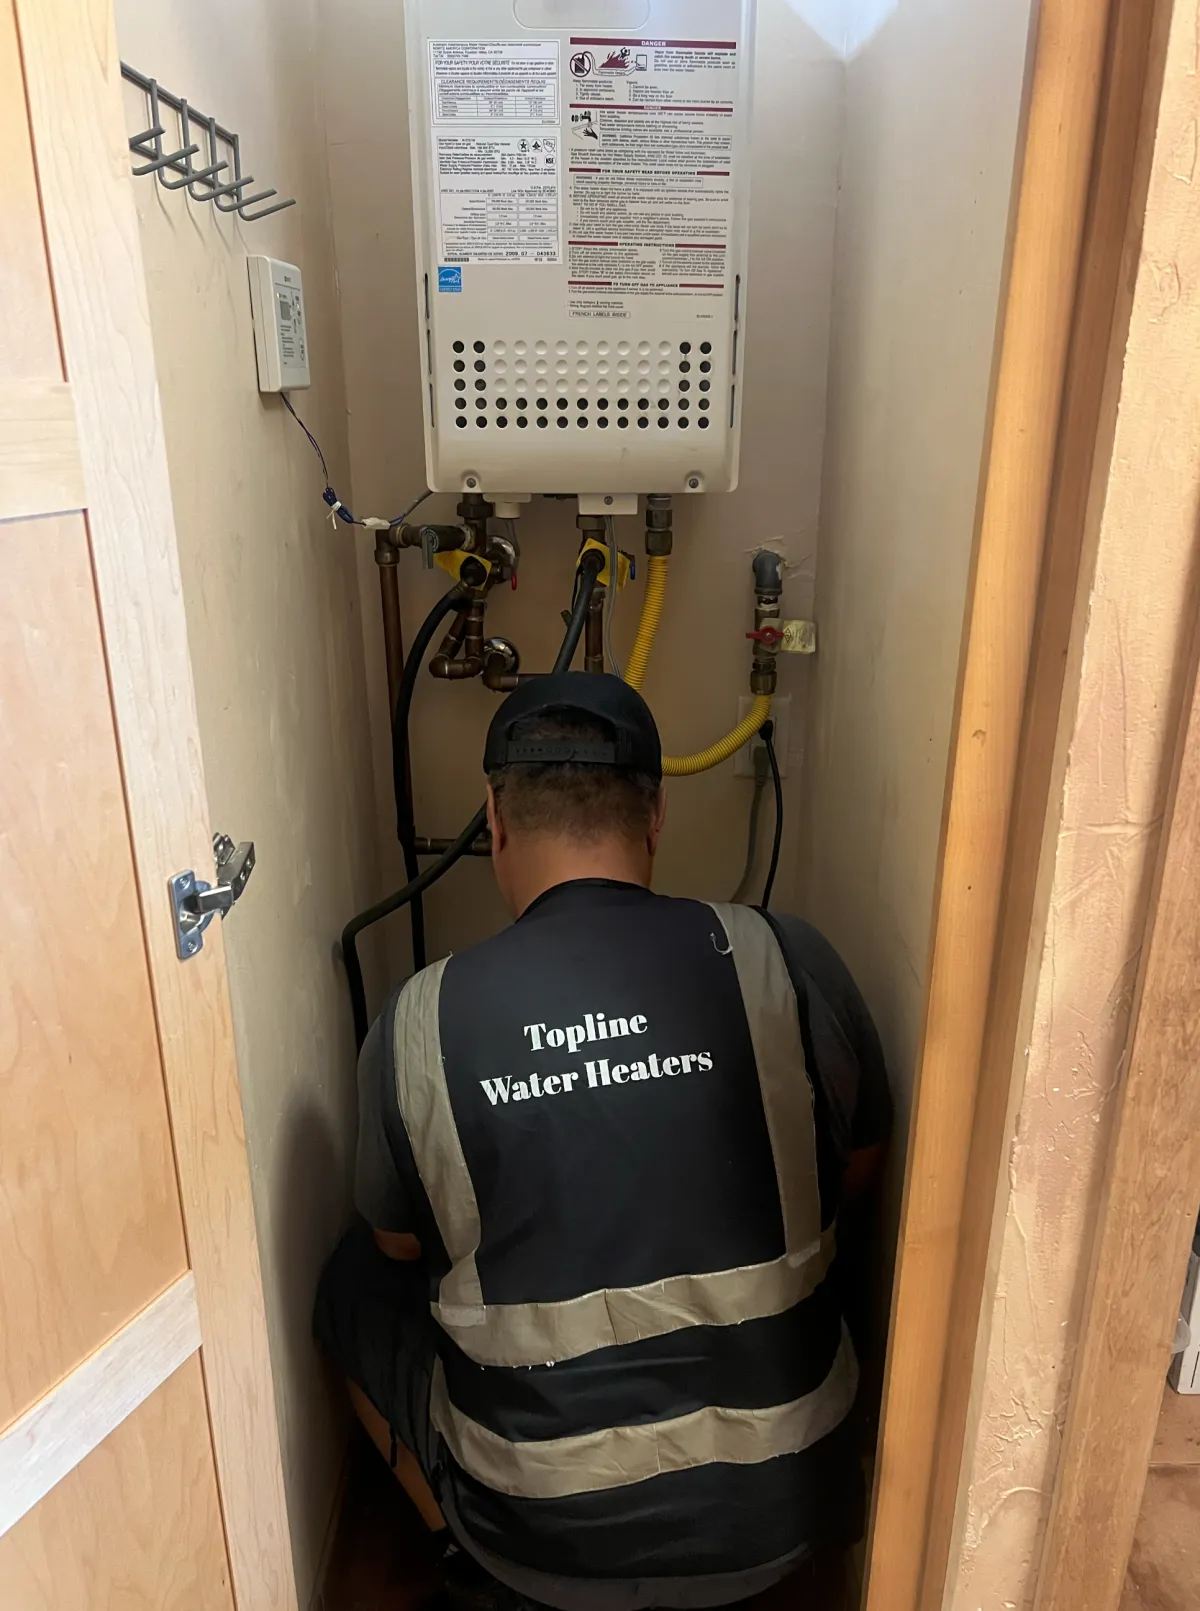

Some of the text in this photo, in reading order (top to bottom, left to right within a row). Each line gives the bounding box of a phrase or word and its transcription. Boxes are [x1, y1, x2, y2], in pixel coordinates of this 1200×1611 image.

[523, 1012, 648, 1053] Topline
[479, 1051, 713, 1106] Water Heaters
